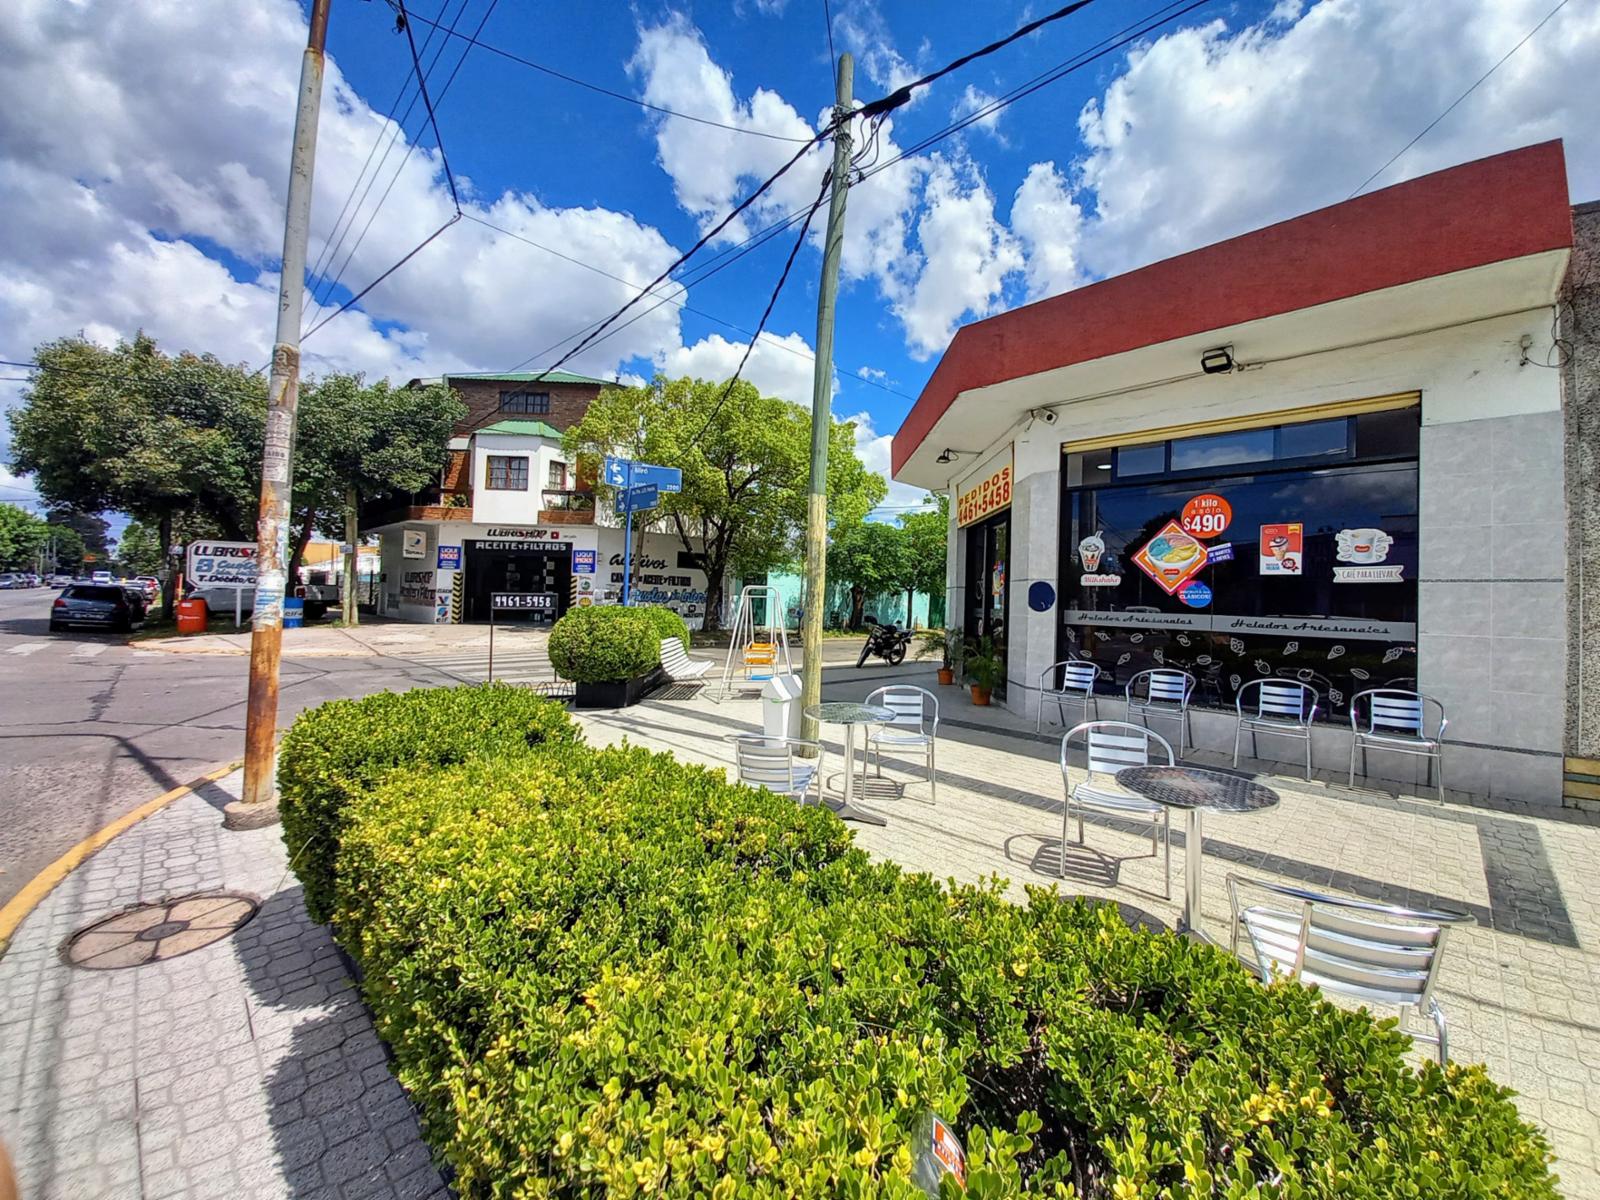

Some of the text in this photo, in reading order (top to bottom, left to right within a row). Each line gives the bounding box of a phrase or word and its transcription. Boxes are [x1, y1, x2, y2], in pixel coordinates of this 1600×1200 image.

[958, 467, 1010, 508] PEDIDOS
[958, 481, 1010, 525] 4461-5458
[1194, 499, 1218, 508] 1 kilo
[1183, 514, 1225, 532] $490
[194, 546, 258, 558] LUBRISH
[475, 541, 519, 550] ACEITE
[523, 542, 566, 551] FILTROS
[1342, 569, 1393, 578] CAFÉ PARA LLEVAR
[1078, 613, 1193, 625] Helados Artesanales
[1230, 618, 1391, 634] Helados Artesanales
